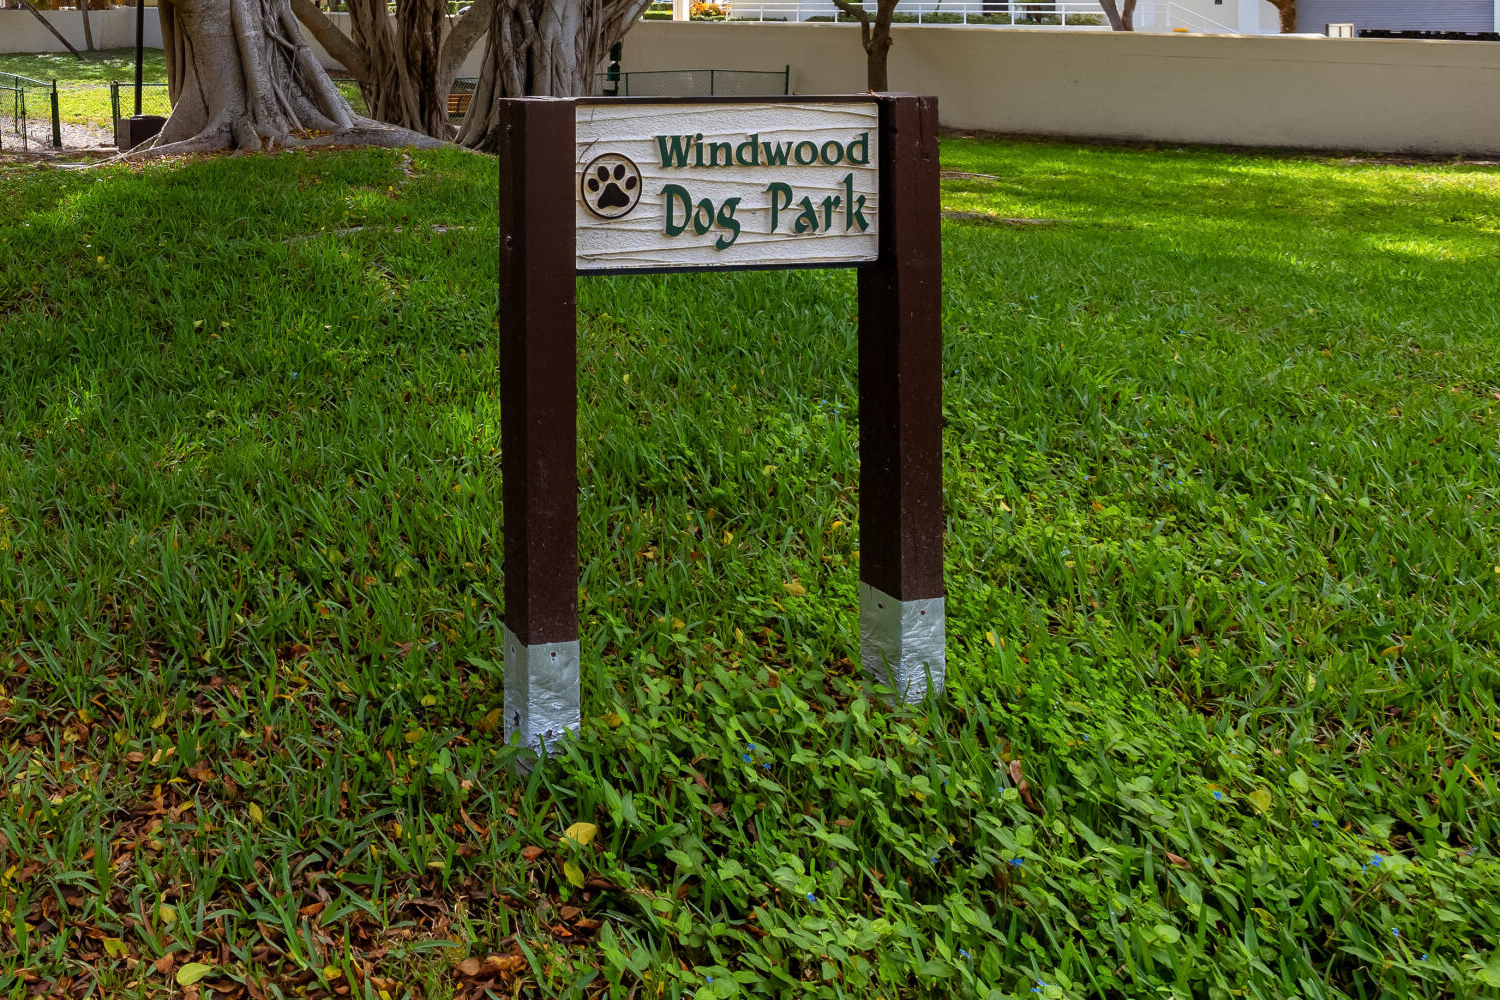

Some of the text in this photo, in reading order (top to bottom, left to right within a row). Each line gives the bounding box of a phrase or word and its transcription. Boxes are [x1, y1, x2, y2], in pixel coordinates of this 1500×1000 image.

[656, 132, 870, 168] Windwood
[660, 173, 870, 251] Dog Park
